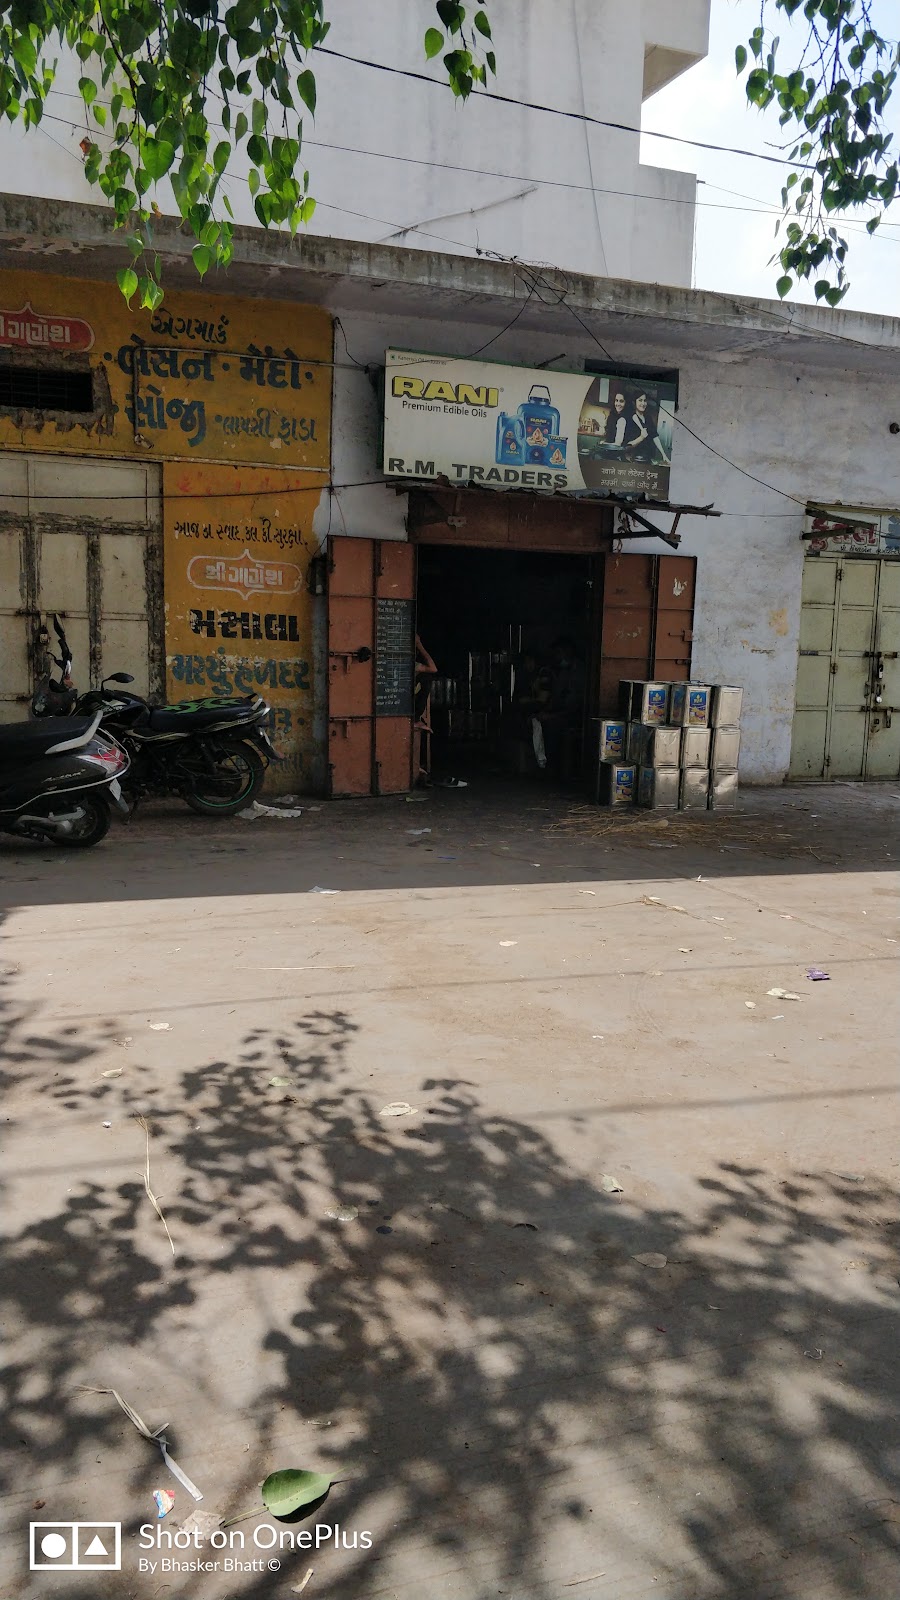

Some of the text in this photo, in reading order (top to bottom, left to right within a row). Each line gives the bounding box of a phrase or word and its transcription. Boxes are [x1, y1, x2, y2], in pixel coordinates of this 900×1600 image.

[392, 375, 499, 408] RANI
[402, 401, 487, 418] Premium Edible Oils
[451, 463, 568, 488] TRADERS
